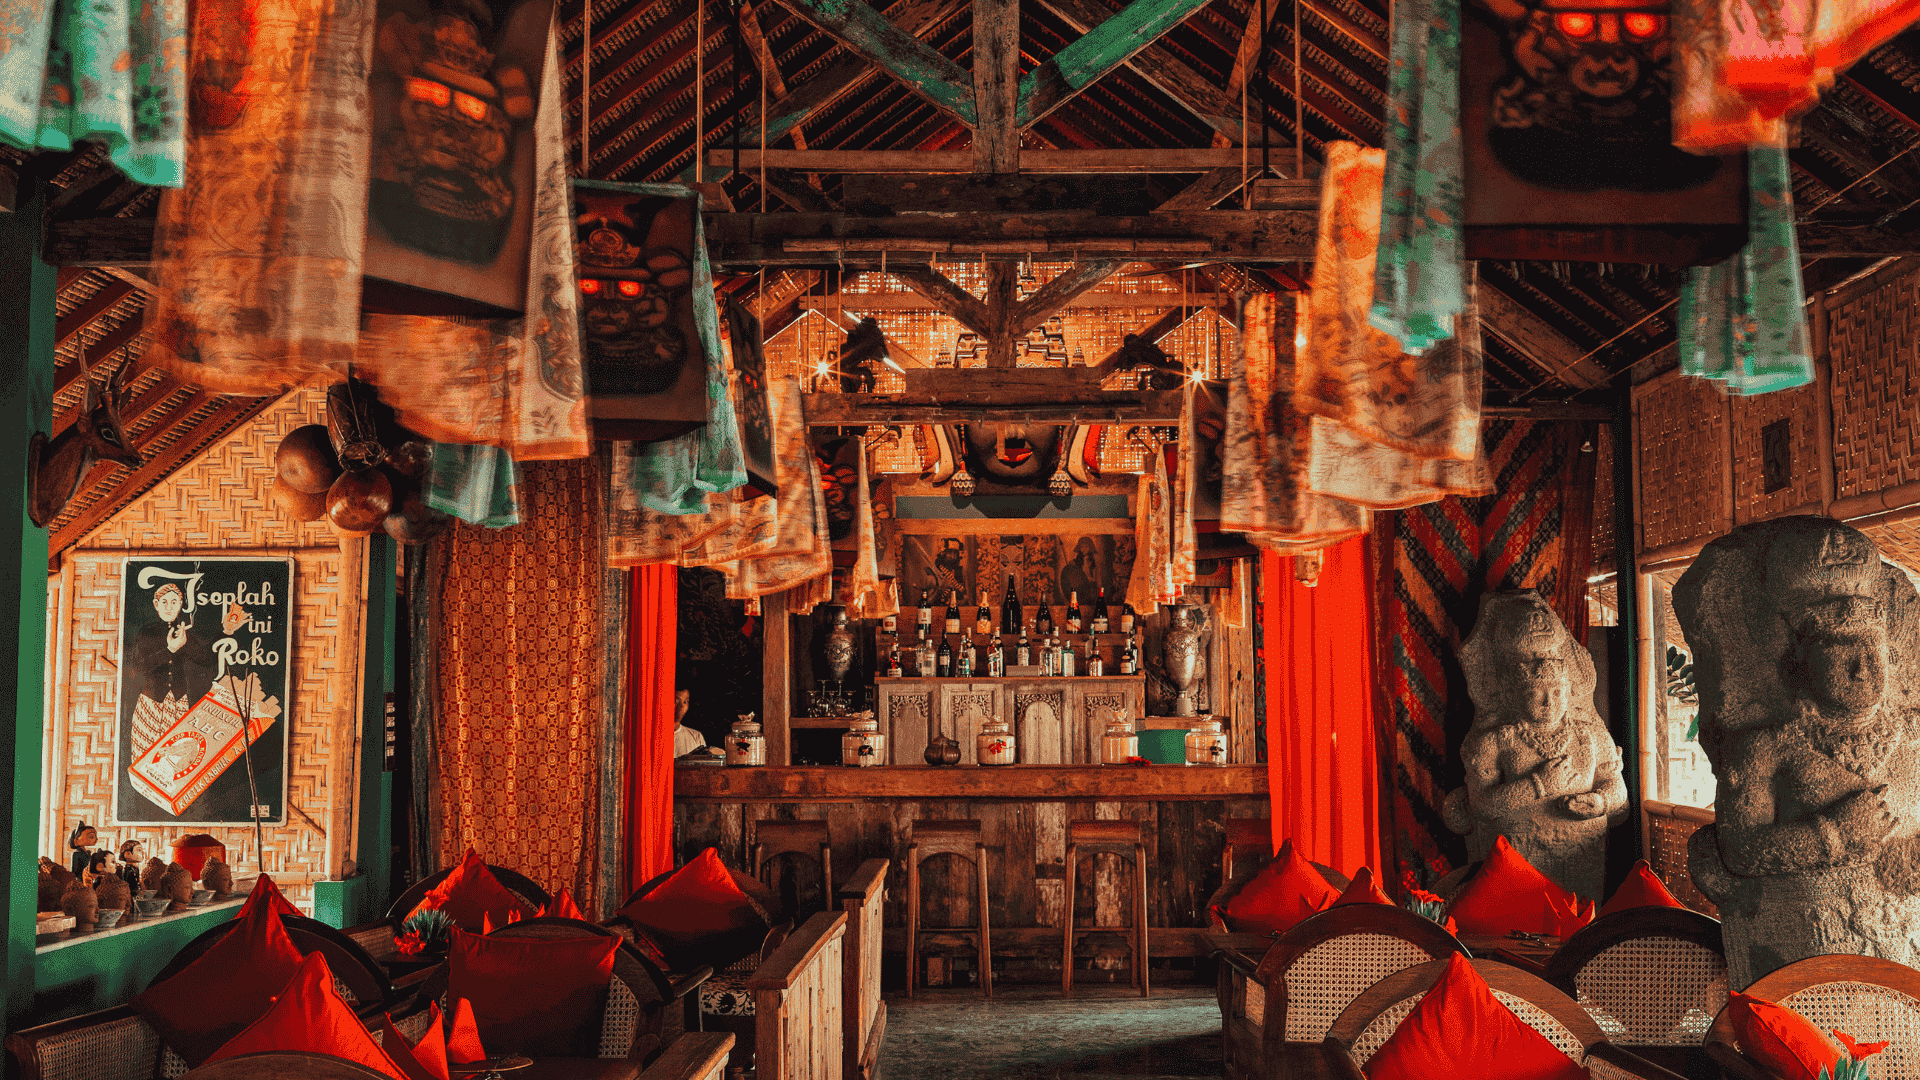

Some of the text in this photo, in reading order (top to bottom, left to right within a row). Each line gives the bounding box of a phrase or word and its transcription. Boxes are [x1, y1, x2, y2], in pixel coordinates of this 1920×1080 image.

[138, 566, 276, 624] Tseplah
[248, 615, 273, 634] ini
[212, 637, 279, 680] Roko
[177, 779, 206, 810] KRETEK
